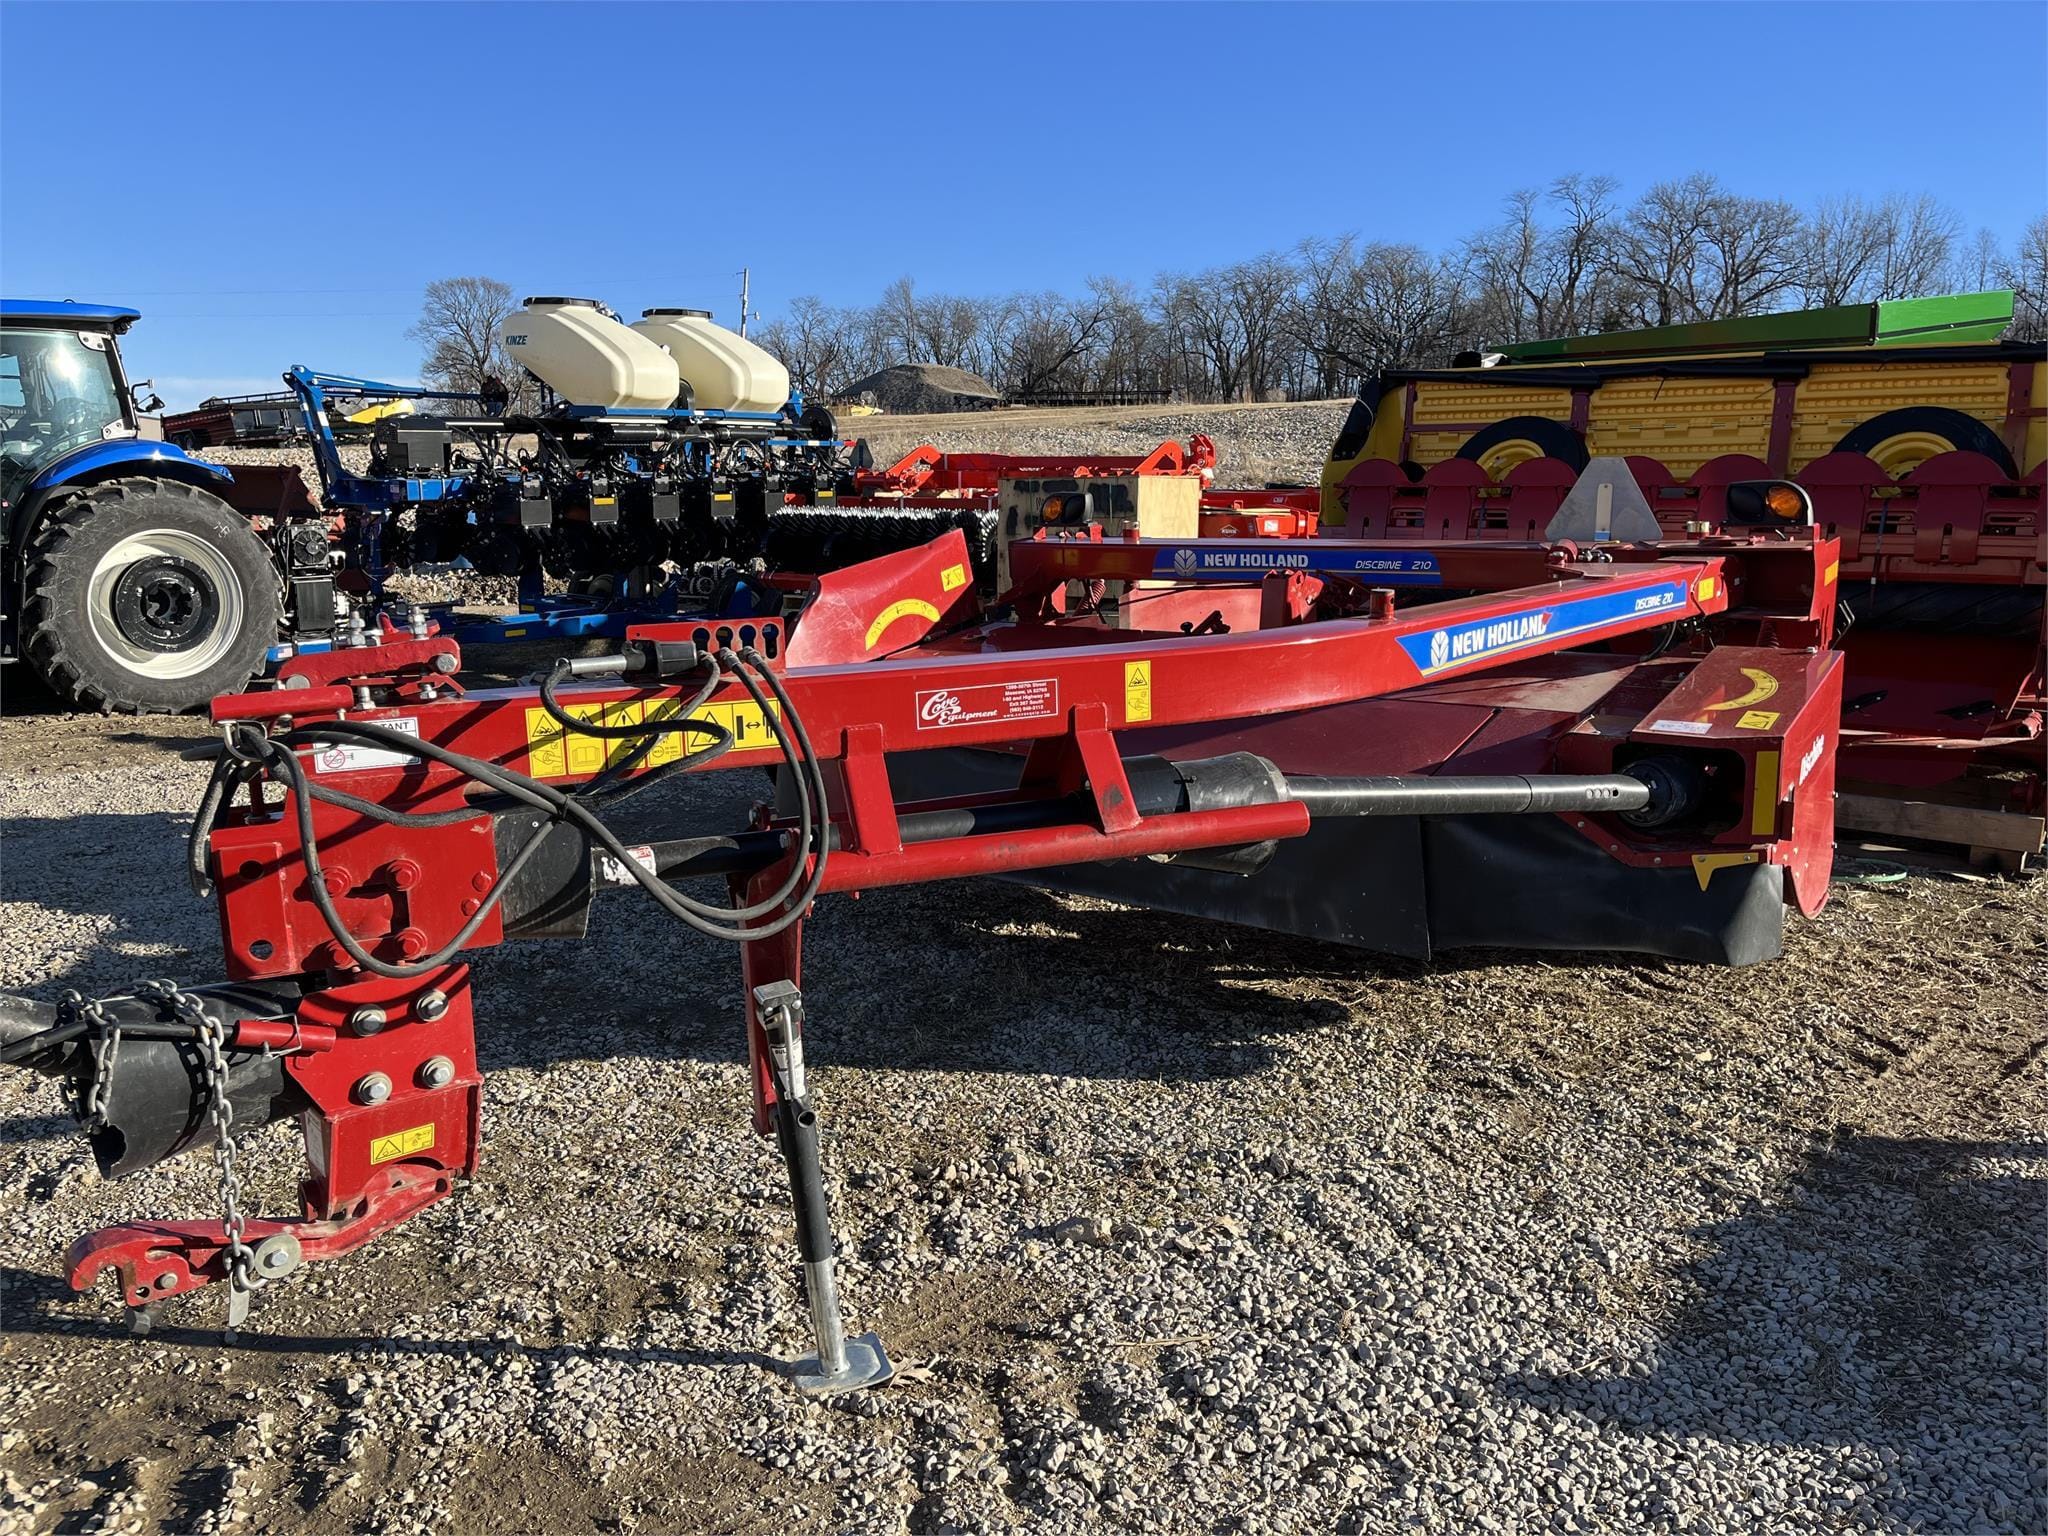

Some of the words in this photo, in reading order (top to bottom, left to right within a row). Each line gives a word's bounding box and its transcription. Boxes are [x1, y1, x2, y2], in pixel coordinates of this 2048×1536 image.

[505, 335, 528, 345] KINZE
[1204, 553, 1236, 566] NEW
[1239, 553, 1309, 567] HOLLAND
[1355, 560, 1401, 570] DISCBINE
[1411, 561, 1432, 570] 210
[1452, 627, 1485, 658] NEW
[1487, 614, 1547, 647] HOLLAND
[1635, 595, 1661, 611] DISCBINE
[1662, 591, 1674, 605] 210
[921, 691, 961, 721] Cove
[938, 710, 997, 725] Equipment
